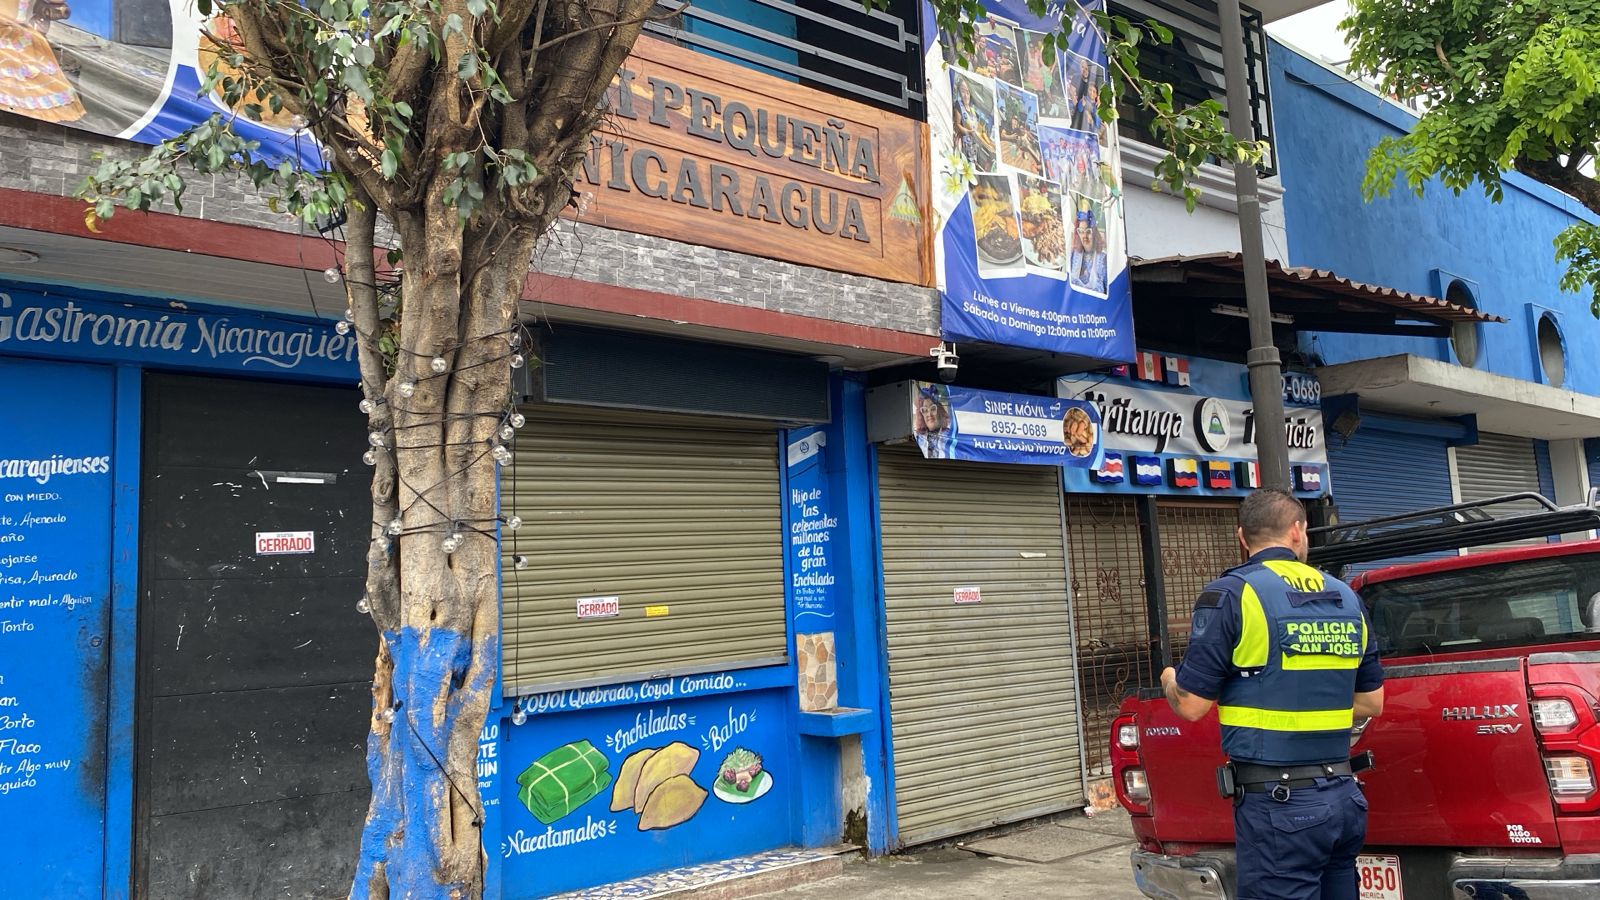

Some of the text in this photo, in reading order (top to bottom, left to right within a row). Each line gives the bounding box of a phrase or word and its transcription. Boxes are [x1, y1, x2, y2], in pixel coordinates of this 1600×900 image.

[648, 76, 881, 186] PEQUEÑA
[574, 134, 871, 243] NICARAGUA
[973, 290, 999, 308] Lunes
[1009, 302, 1040, 319] Viernes
[1041, 310, 1071, 325] 4:00pm
[1079, 314, 1107, 328] 11:00pm
[963, 301, 999, 322] Sábado
[1001, 317, 1007, 325] a
[1009, 317, 1046, 336] Domingo
[1047, 325, 1080, 338] 12:00md
[1087, 328, 1116, 340] 11:00pm
[1015, 402, 1048, 418] MÓVIL
[991, 420, 1047, 437] 8952-0689
[5, 493, 62, 502] CON MIEDO.
[792, 488, 821, 508] Hijo de
[802, 504, 819, 518] las
[0, 511, 66, 528] te, Apenado
[0, 532, 25, 543] año
[258, 537, 312, 552] CERRADO
[792, 531, 829, 545] millones
[798, 544, 824, 557] de la
[0, 554, 38, 568] ojarse
[801, 557, 826, 572] gran
[0, 569, 78, 585] risa, Apurado
[793, 571, 835, 587] Enchilada
[29, 593, 52, 607] mal
[955, 591, 980, 601] CERRADO
[578, 602, 618, 616] CERRADO
[1, 618, 34, 635] Tonto
[1286, 621, 1358, 635] POLICIA
[1298, 634, 1352, 643] MUNICIPAL
[1325, 643, 1360, 655] JOSE
[640, 677, 674, 700] Coyol
[1442, 703, 1520, 720] HILUX
[614, 706, 748, 754] Enchiladas Baho
[1145, 727, 1181, 737] TOYOTA
[1477, 723, 1524, 735] SRV
[0, 738, 41, 755] Flaco
[476, 742, 498, 759] TE
[15, 758, 41, 778] Algo
[45, 759, 70, 771] muy
[504, 815, 607, 858] Nacatamales
[1358, 857, 1374, 865] RICA
[1358, 866, 1396, 891] 850
